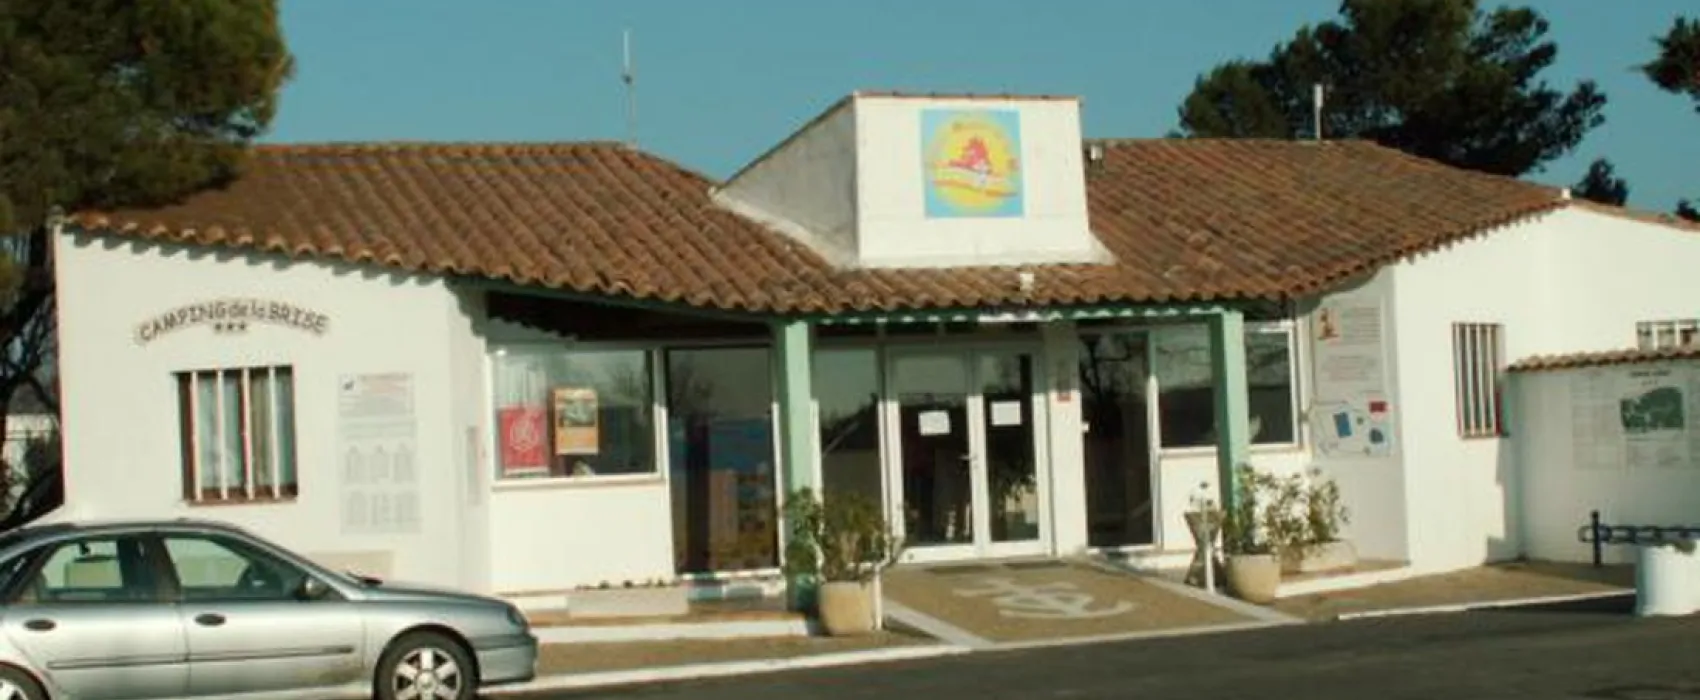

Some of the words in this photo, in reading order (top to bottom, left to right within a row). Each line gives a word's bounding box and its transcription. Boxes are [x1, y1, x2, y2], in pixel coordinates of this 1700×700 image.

[139, 301, 226, 341] CAMPING
[228, 301, 248, 319] de
[268, 301, 330, 335] BRISE
